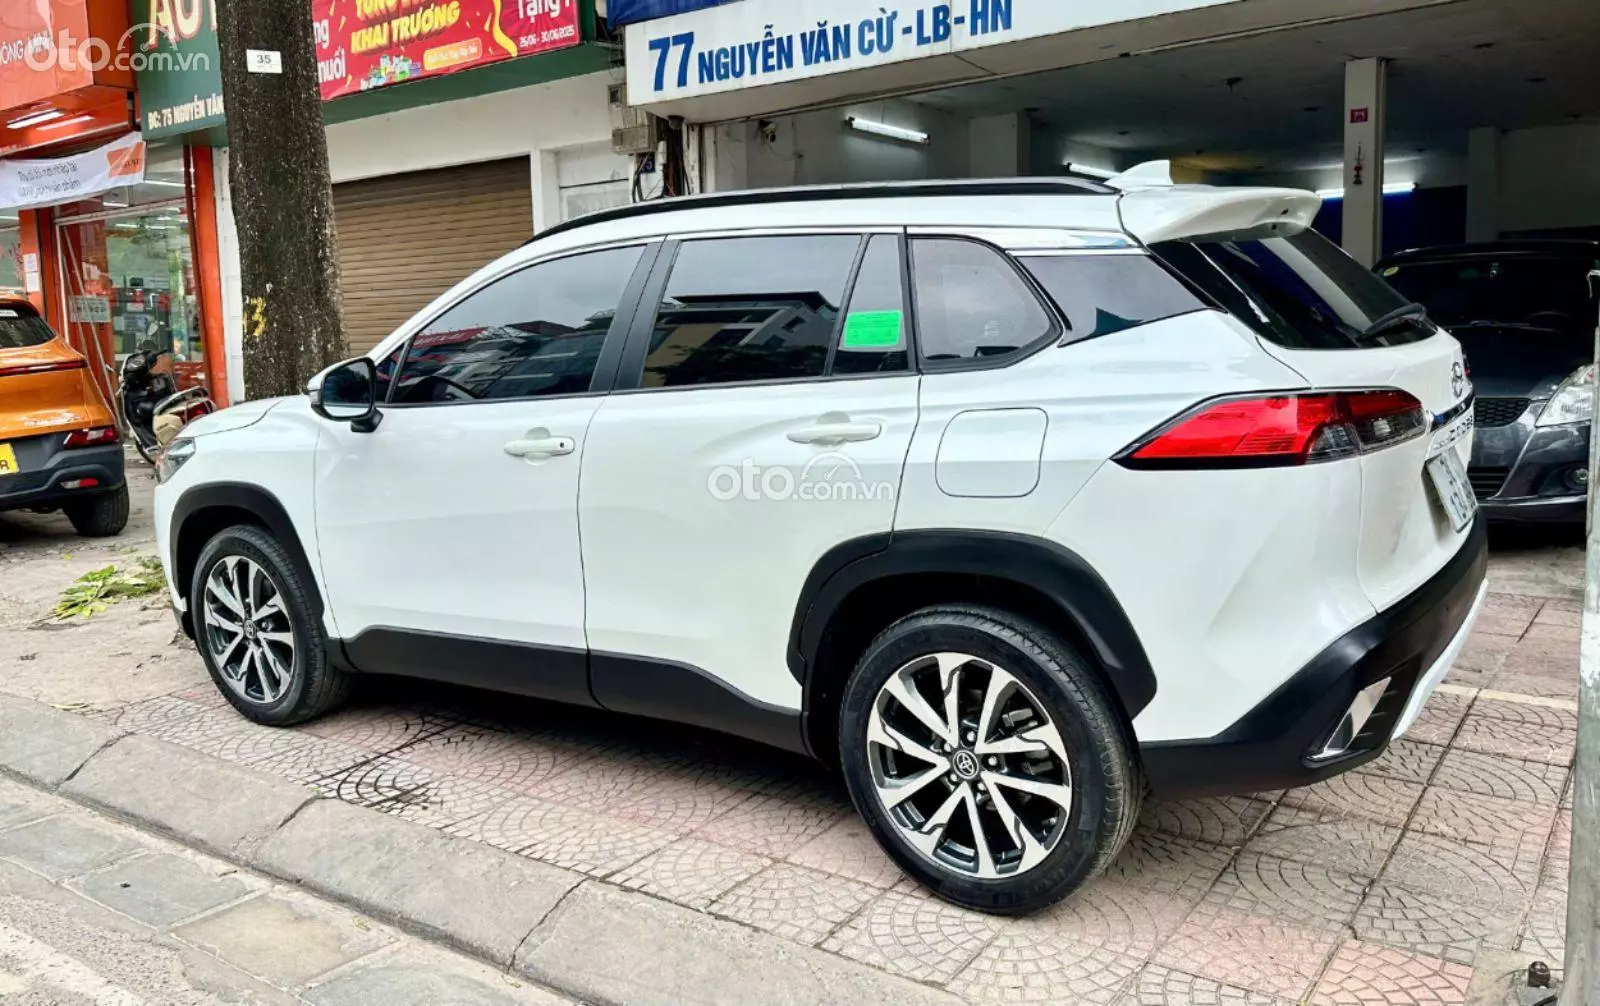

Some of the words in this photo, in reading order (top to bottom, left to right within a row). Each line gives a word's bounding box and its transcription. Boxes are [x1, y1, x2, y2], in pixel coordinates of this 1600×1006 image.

[351, 21, 389, 53] KHAI
[391, 2, 460, 40] TRƯƠNG
[0, 41, 24, 65] ÔNG
[256, 54, 272, 64] 35
[648, 31, 695, 92] 77
[697, 24, 793, 84] NGUYỄN
[801, 20, 851, 66] VĂN
